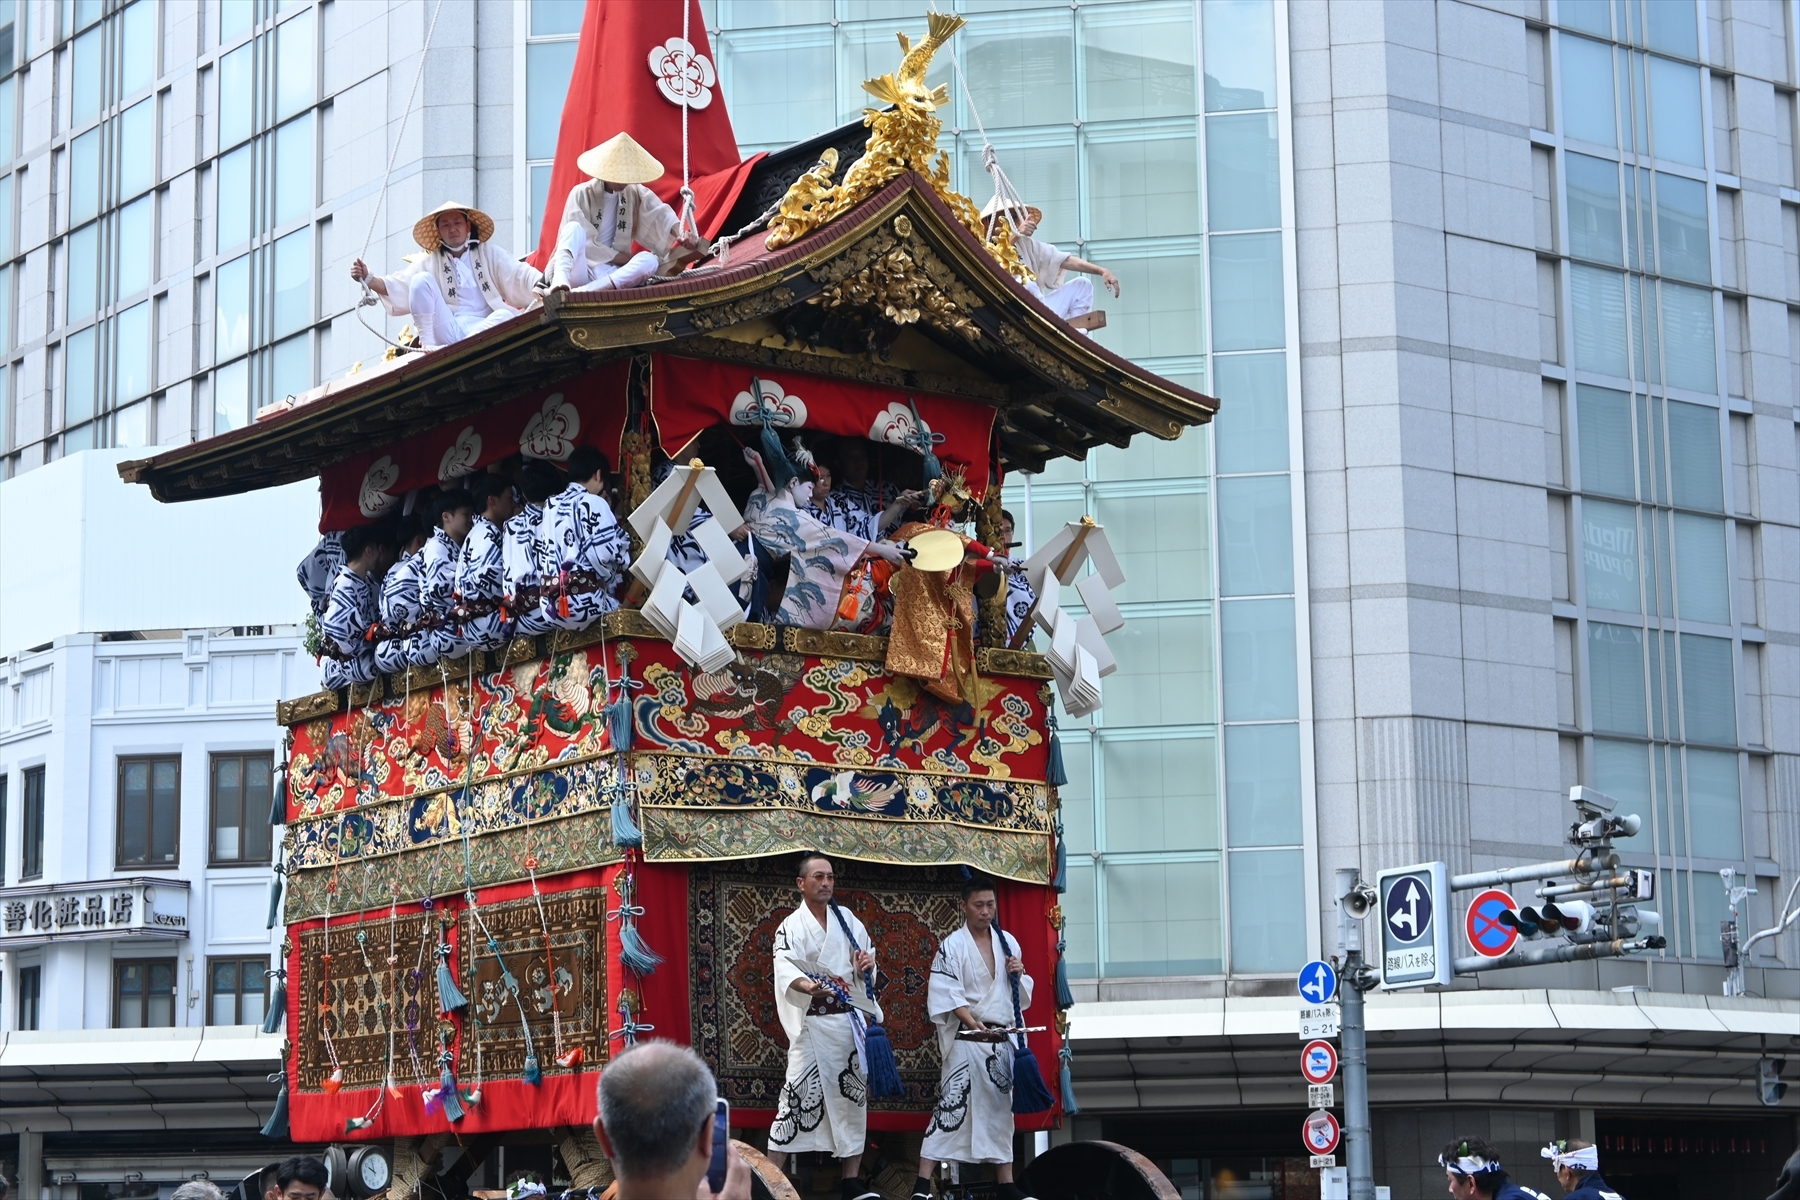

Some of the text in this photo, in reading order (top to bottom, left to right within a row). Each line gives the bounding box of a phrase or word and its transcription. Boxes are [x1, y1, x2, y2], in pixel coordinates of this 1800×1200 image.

[618, 193, 627, 232] 長刀鉾
[443, 263, 456, 298] 長刀鉾
[475, 259, 490, 292] 長刀鉾
[3, 892, 133, 932] 善化粧品店
[1387, 952, 1434, 971] 路線バスを除く
